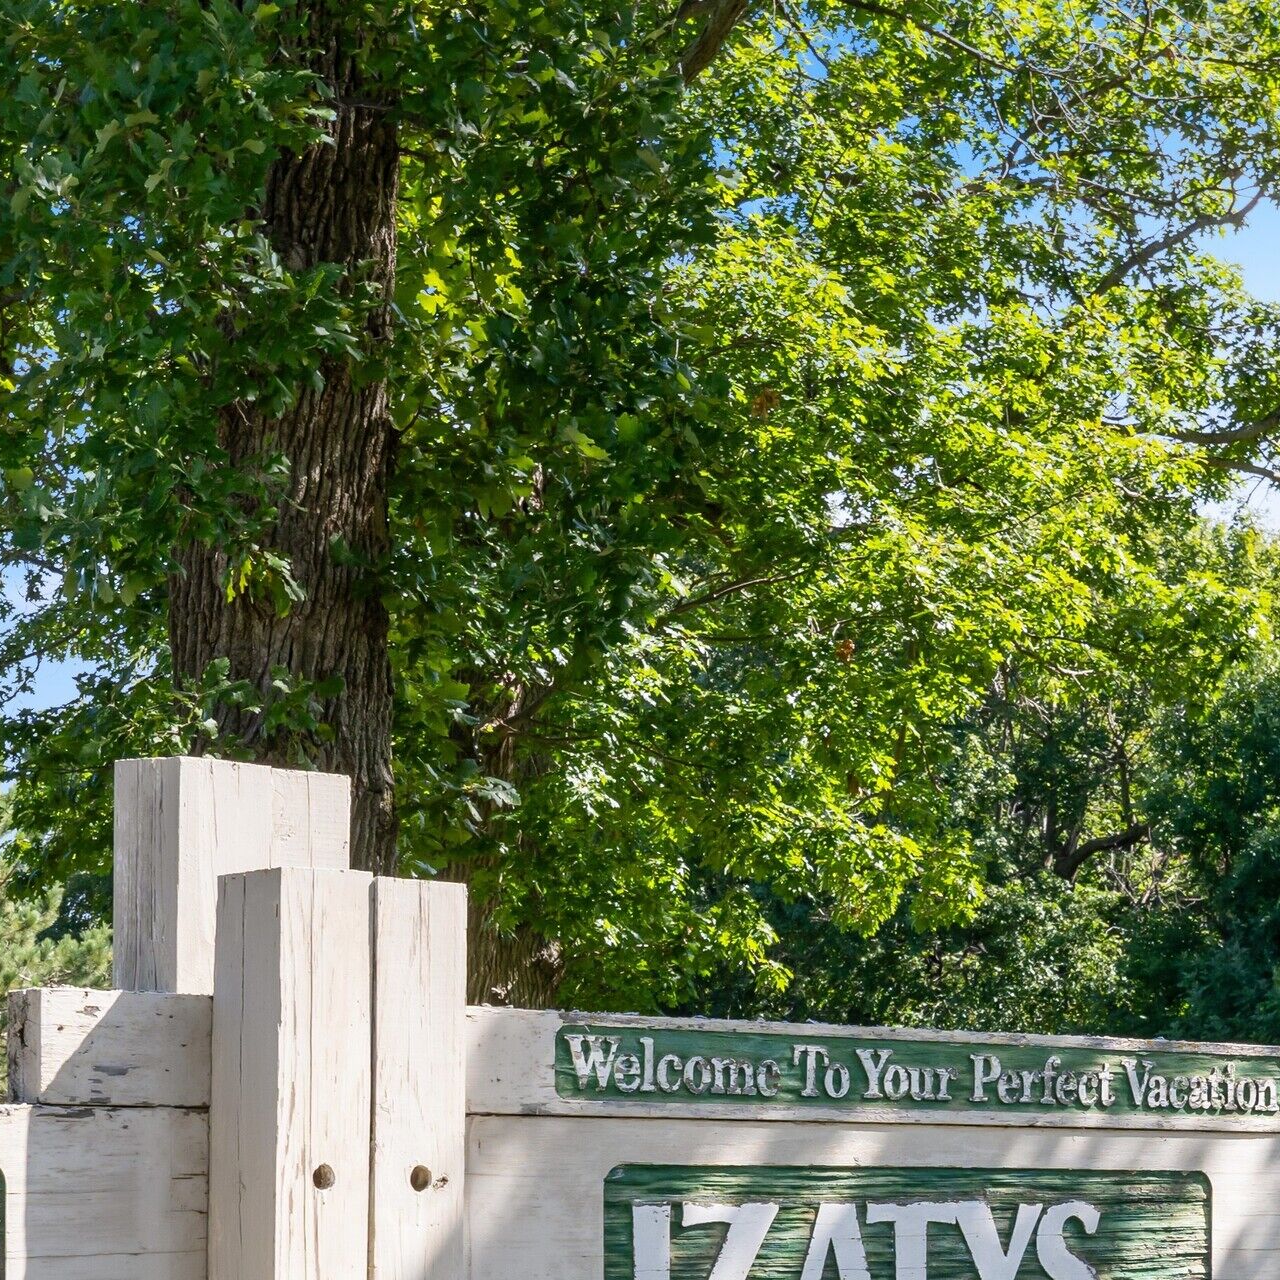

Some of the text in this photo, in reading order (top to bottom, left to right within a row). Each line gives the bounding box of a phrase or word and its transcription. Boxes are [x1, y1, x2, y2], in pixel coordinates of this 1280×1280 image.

[563, 1034, 1280, 1115] Welcome To Your Perfect Vacation
